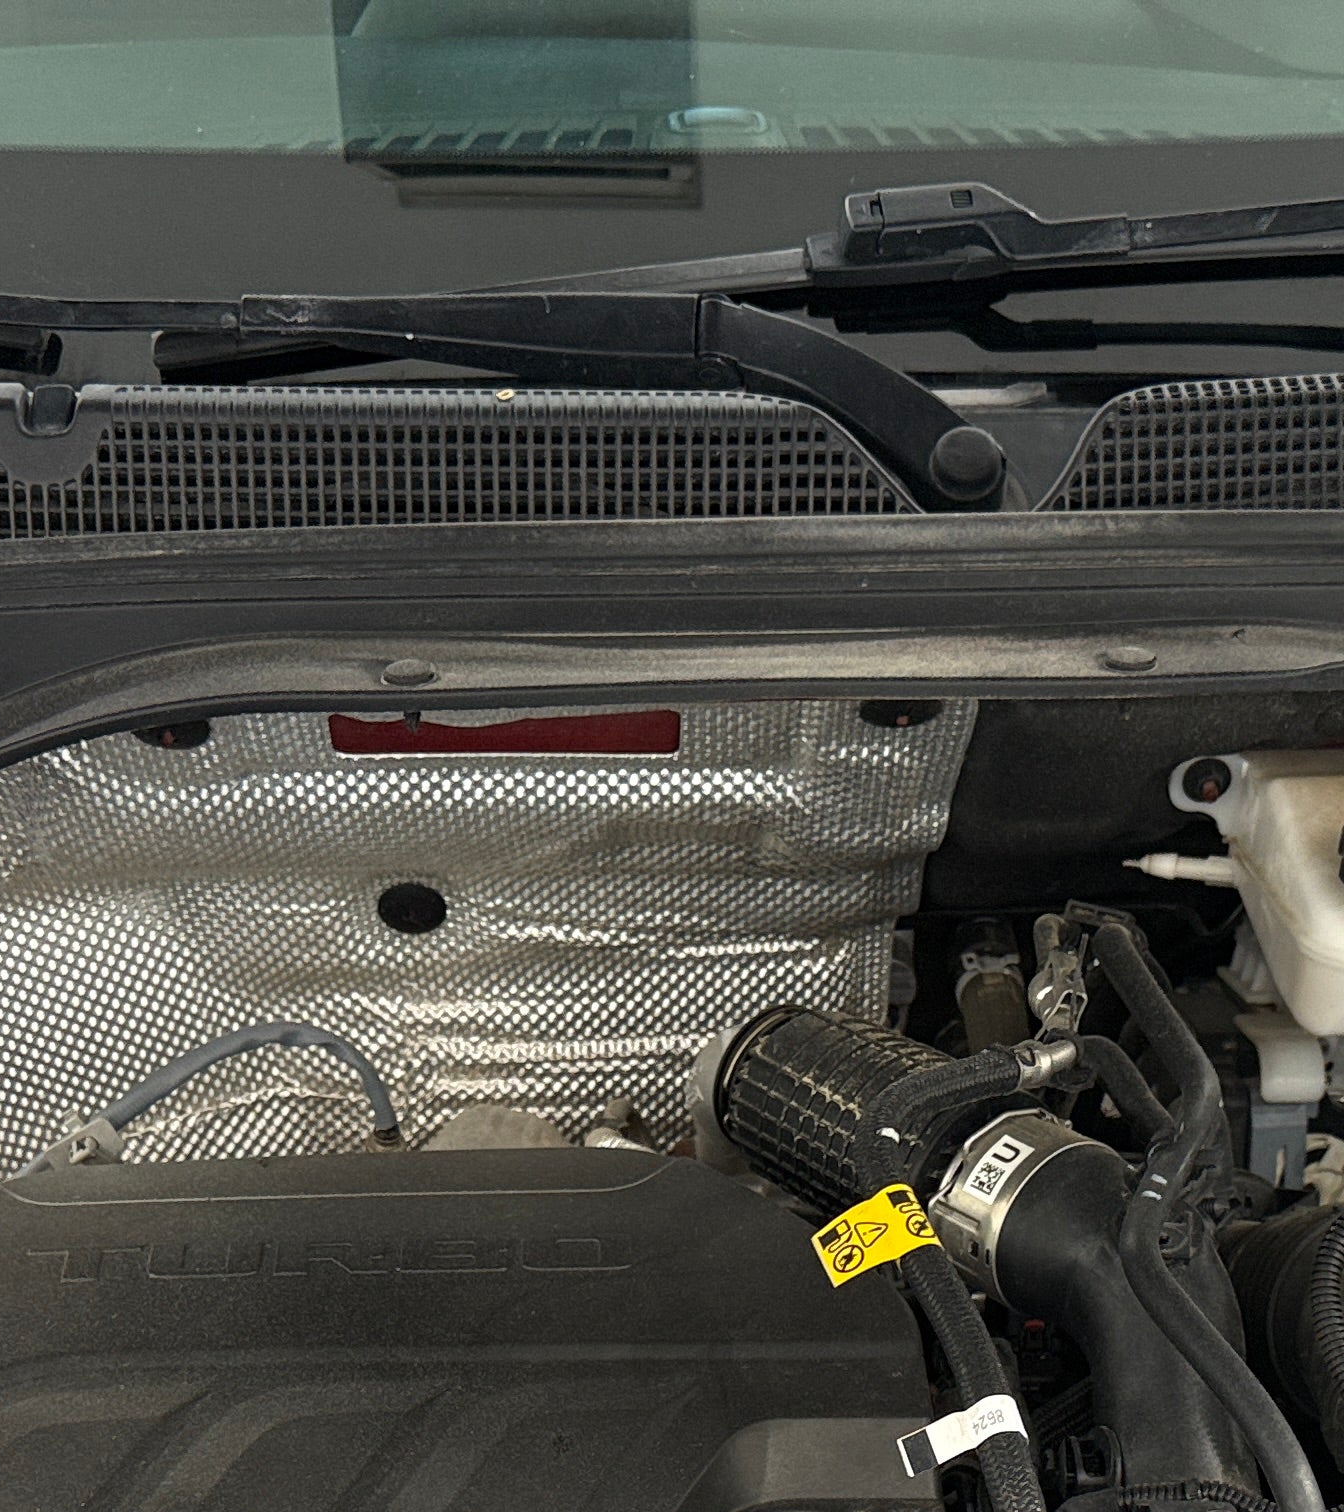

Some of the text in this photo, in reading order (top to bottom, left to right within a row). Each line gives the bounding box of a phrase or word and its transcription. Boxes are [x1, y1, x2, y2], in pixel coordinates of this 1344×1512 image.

[991, 1142, 1021, 1164] U
[27, 1237, 632, 1283] TURBO
[972, 1409, 1005, 1436] 8624
